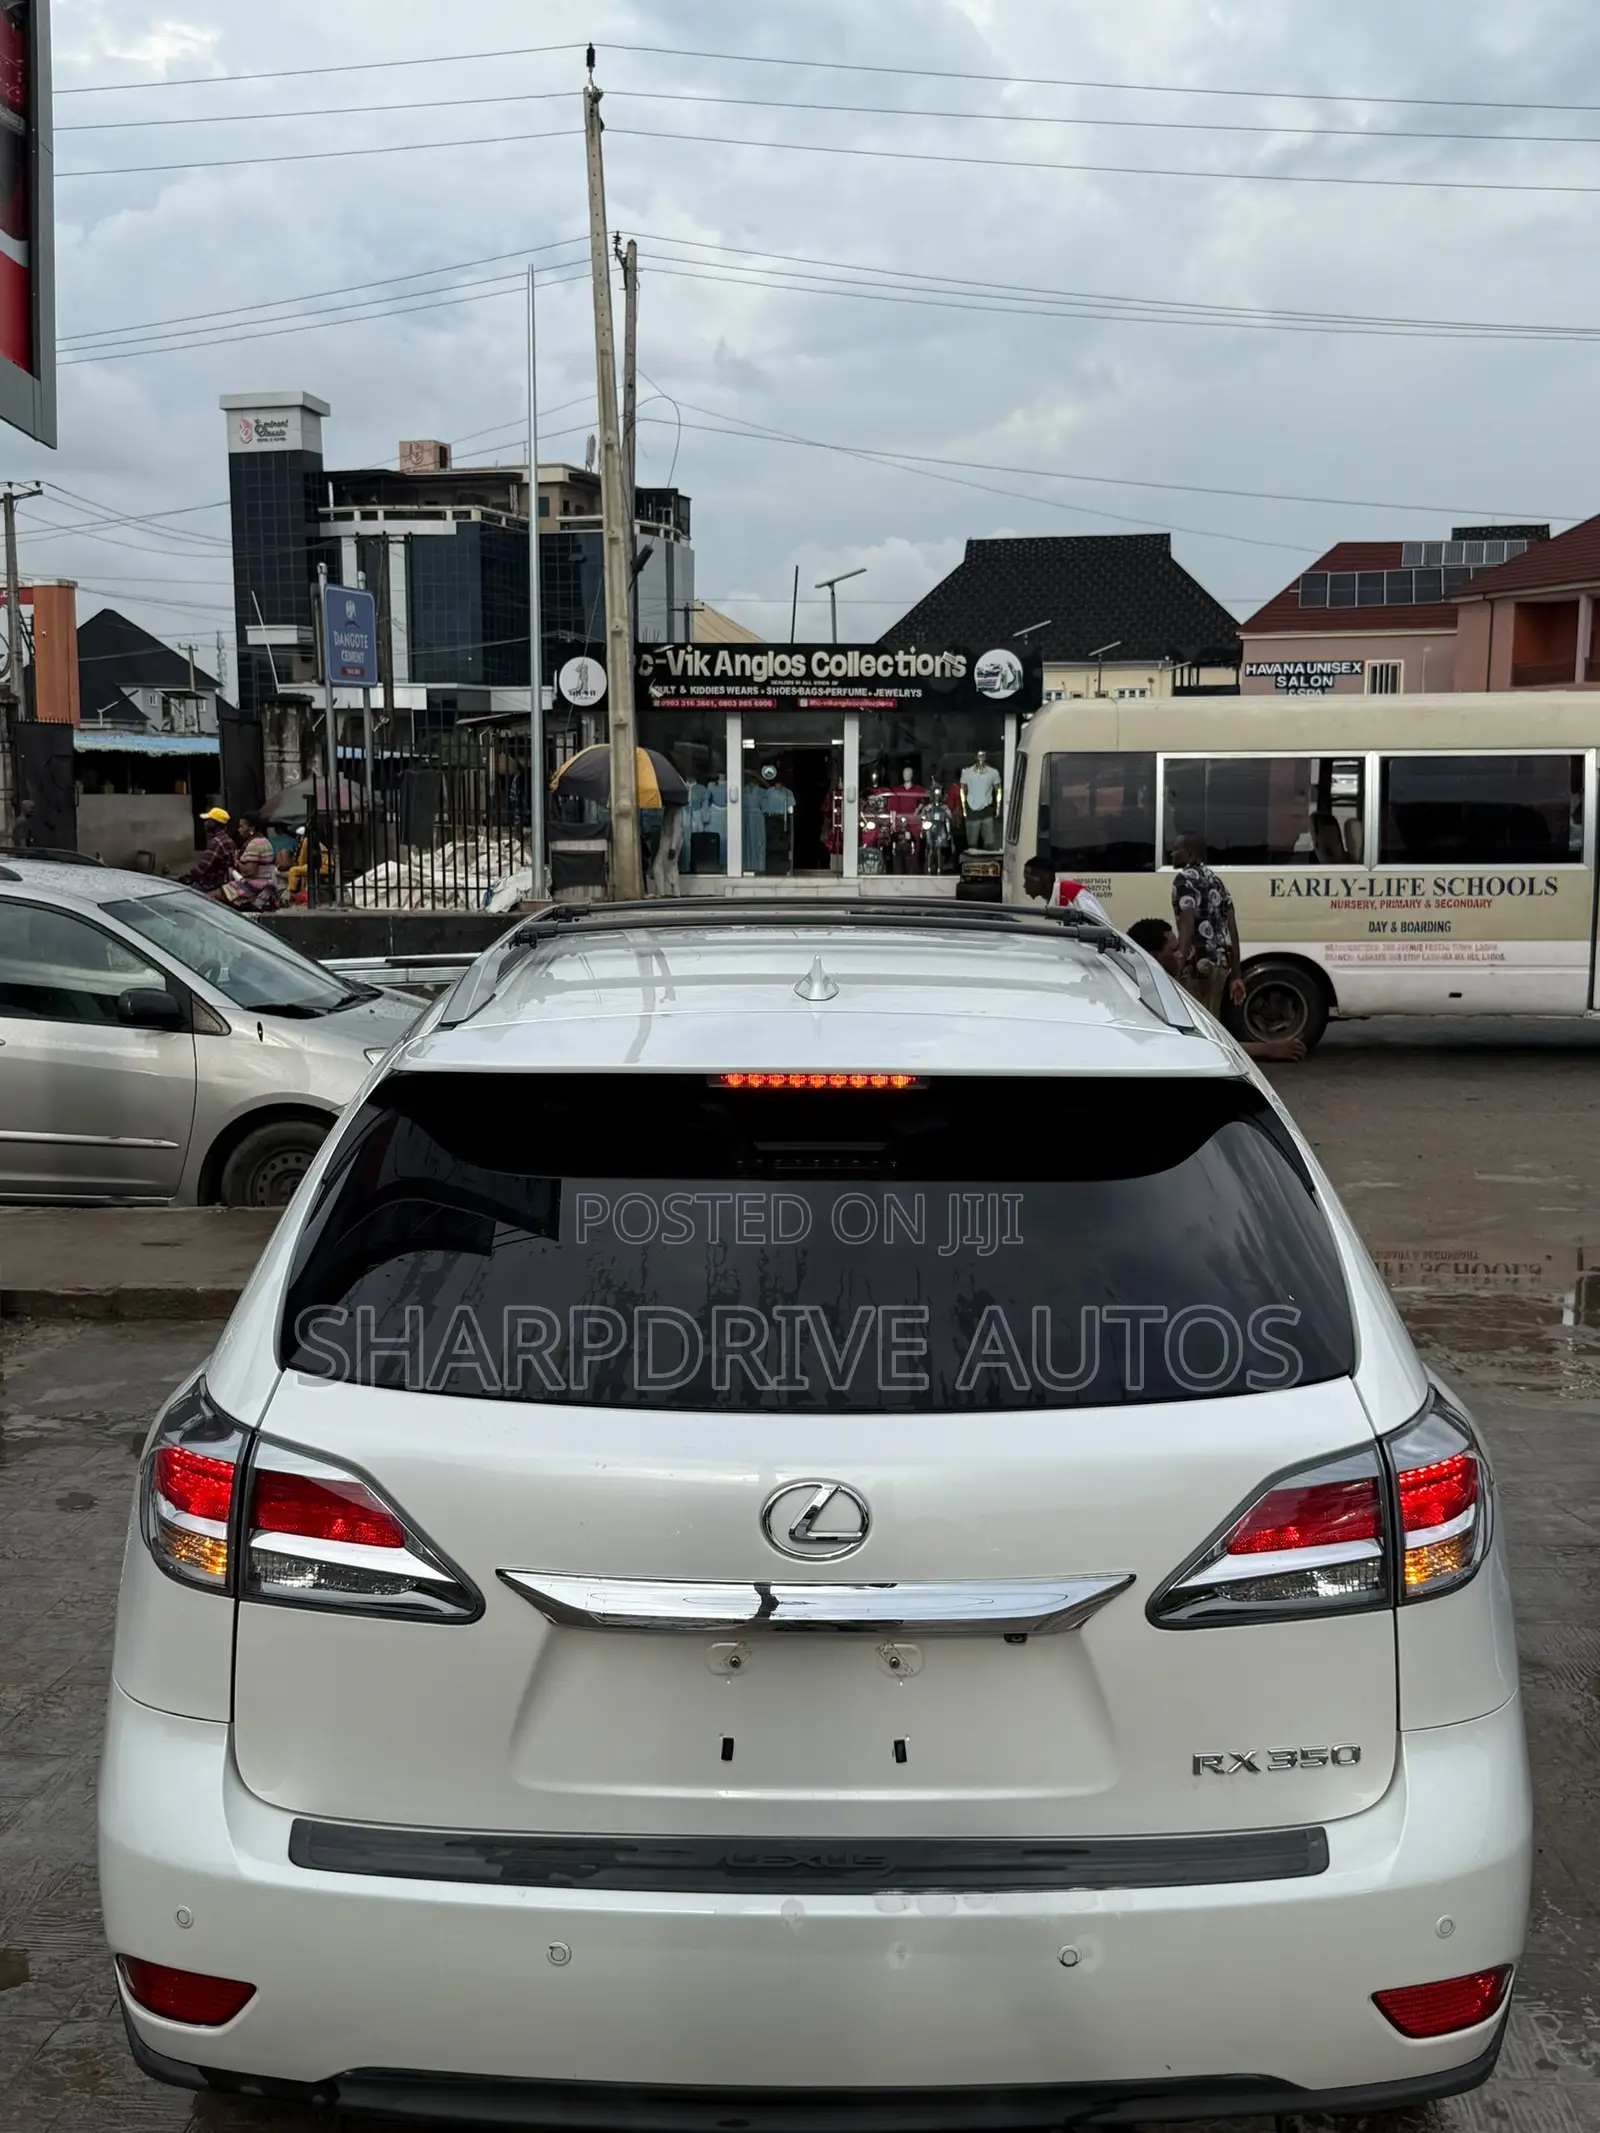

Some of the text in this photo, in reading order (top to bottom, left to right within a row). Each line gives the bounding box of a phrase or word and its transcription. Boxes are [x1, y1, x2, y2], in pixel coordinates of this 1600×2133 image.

[333, 630, 369, 649] DANGOTE
[341, 650, 365, 664] CEMENT
[713, 650, 807, 683] Anglos
[811, 645, 967, 678] Collections
[1245, 661, 1362, 676] HAVANA UNISEX
[1276, 675, 1334, 687] SALON
[679, 685, 687, 695] &
[690, 685, 725, 695] KIDDIES
[726, 686, 759, 696] WEARS
[873, 688, 923, 698] JEWELRYS
[1269, 876, 1558, 898] EARLY-LIFE SCHOOLS
[1330, 900, 1378, 911] NURSERY,
[1379, 899, 1422, 909] PRIMARY
[1434, 899, 1493, 909] SECONDARY
[1368, 920, 1452, 934] DAY & BOARDING
[1192, 1743, 1362, 1776] RX 350
[724, 1853, 890, 1869] LEXUS
